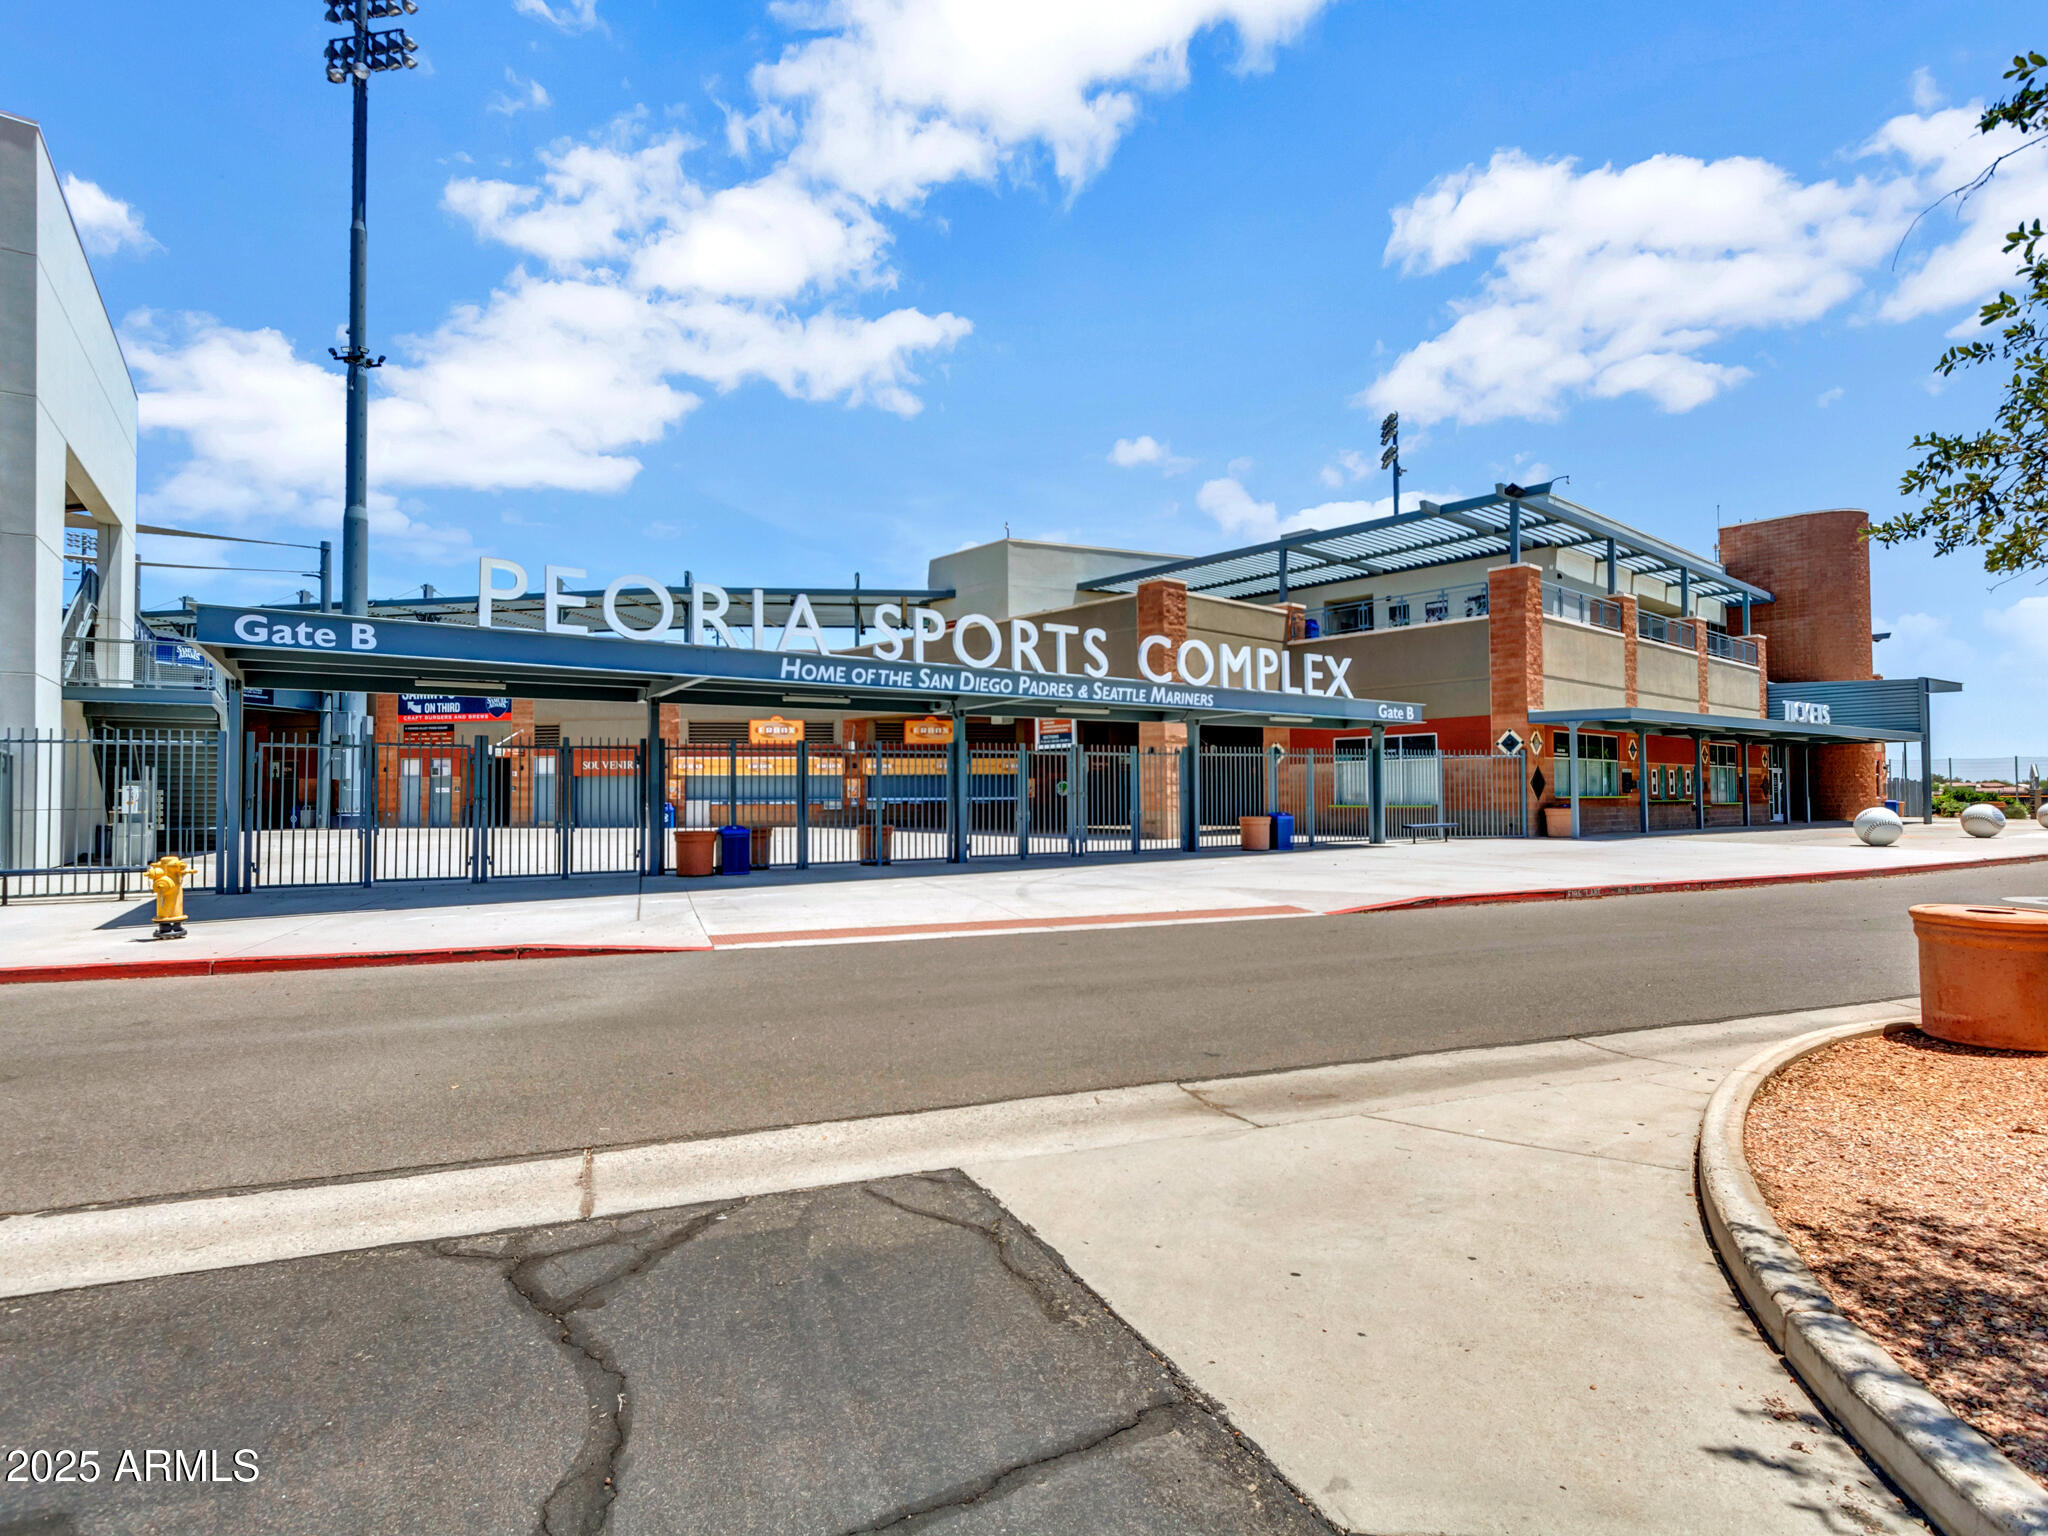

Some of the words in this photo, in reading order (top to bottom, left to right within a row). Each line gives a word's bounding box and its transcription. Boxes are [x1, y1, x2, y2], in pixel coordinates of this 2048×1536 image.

[234, 614, 337, 647] Gate
[351, 623, 377, 650] B
[478, 556, 831, 657] PEORIA
[873, 603, 1109, 678] SPORTS
[1137, 634, 1355, 699] COMPLEX
[780, 657, 847, 683] HOME
[851, 667, 876, 685] OF
[877, 670, 913, 687] THE
[918, 668, 954, 689] SAN
[959, 671, 1013, 694] DIEGO
[1018, 676, 1073, 698] PADRES
[1078, 684, 1088, 699] &
[1093, 682, 1147, 703] SEATTLE
[1150, 686, 1214, 707] MARINERS
[424, 703, 436, 713] ON
[437, 702, 461, 713] THIRD
[1378, 704, 1404, 720] Gate
[1406, 706, 1414, 720] B
[1782, 700, 1831, 725] TICKETS
[582, 760, 640, 770] SOUVENIR
